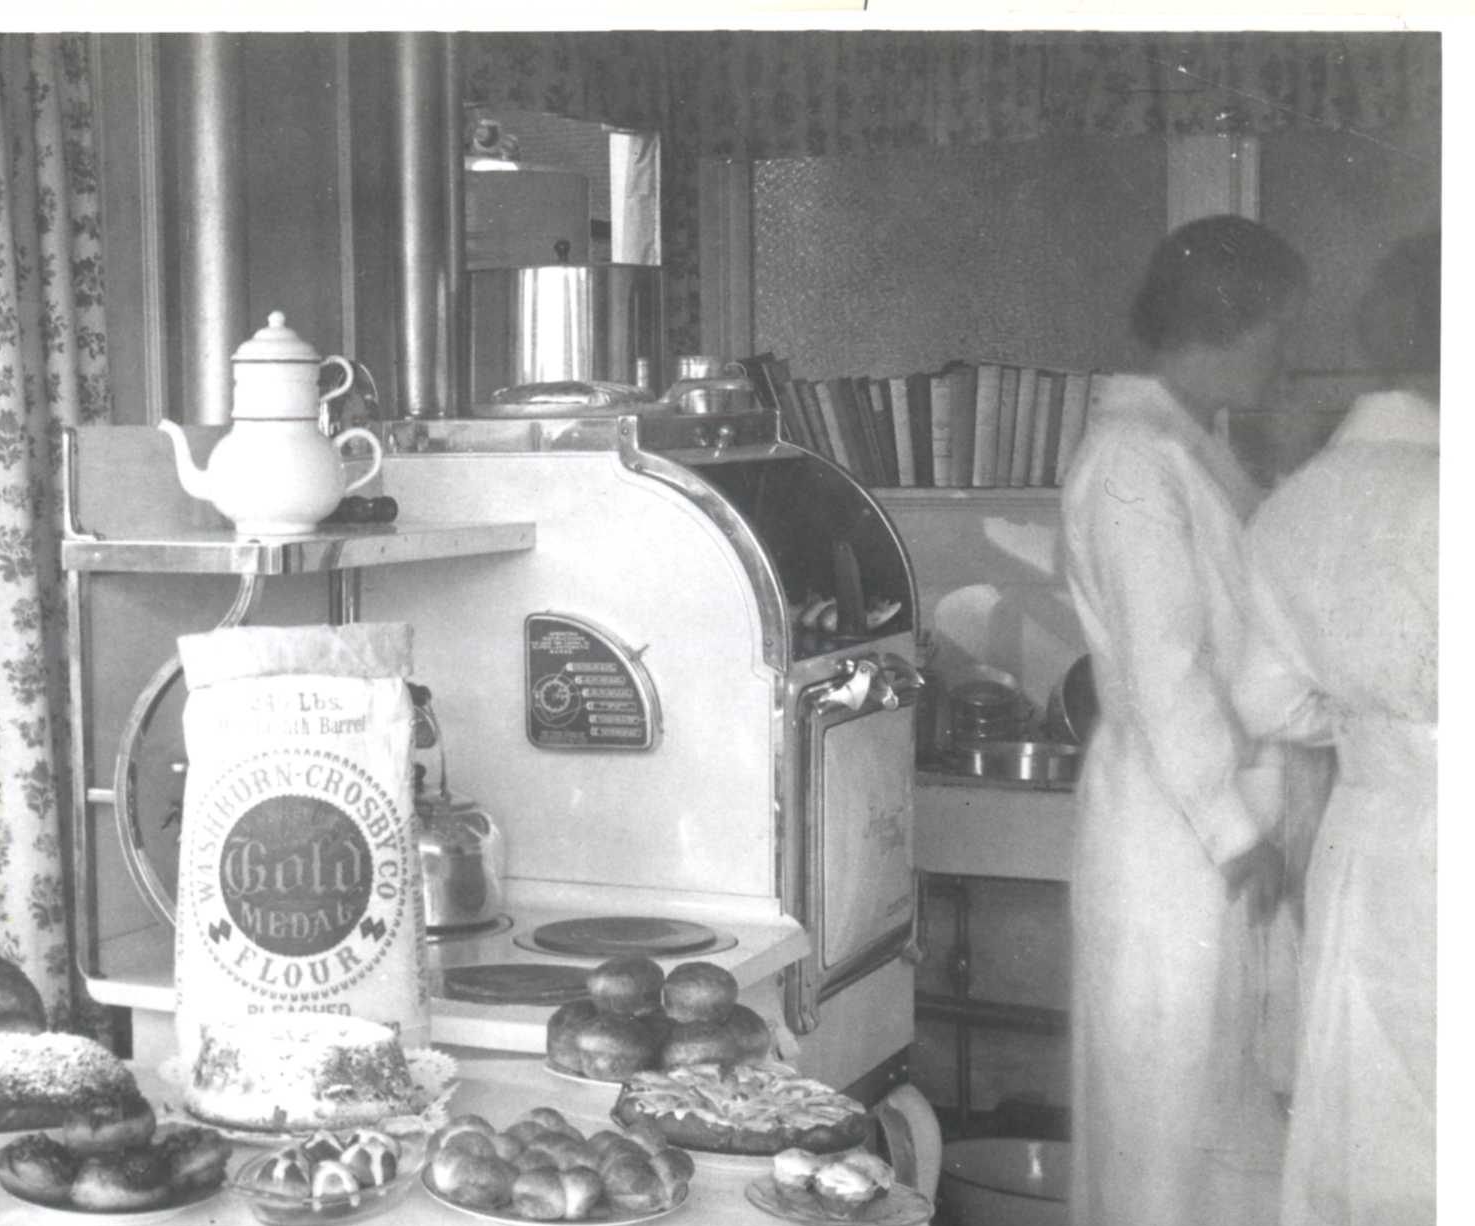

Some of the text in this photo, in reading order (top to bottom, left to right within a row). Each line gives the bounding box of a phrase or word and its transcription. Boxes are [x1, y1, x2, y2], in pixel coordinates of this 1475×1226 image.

[225, 836, 363, 898] Gold
[240, 901, 355, 943] MEDAL
[234, 945, 362, 989] FLOUR
